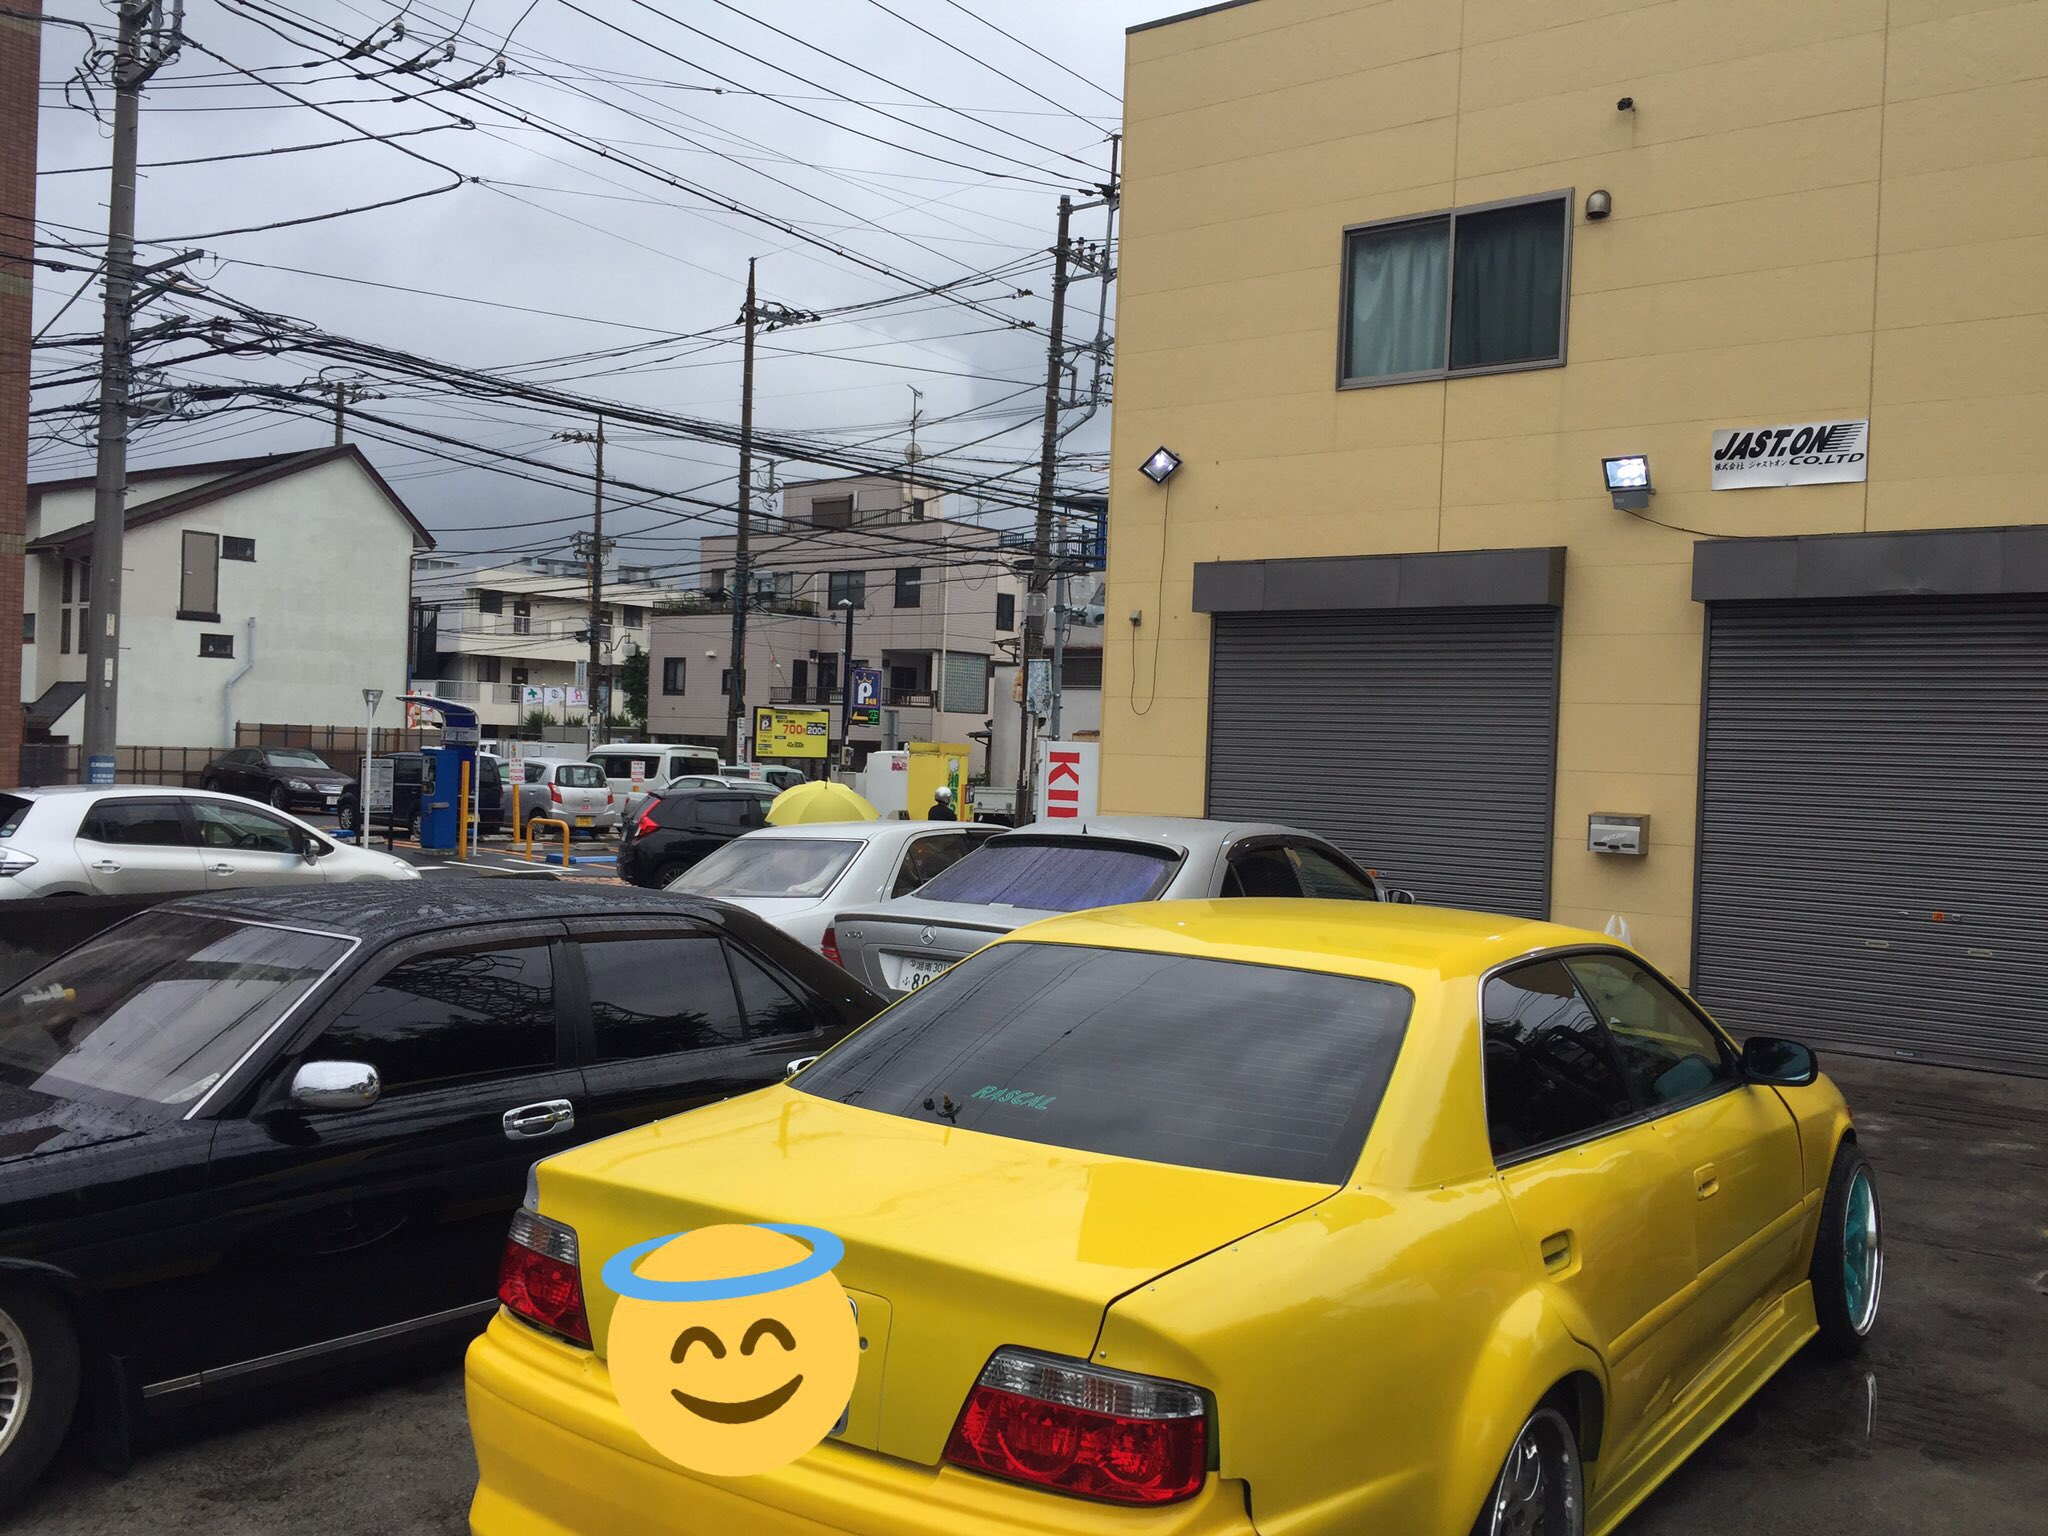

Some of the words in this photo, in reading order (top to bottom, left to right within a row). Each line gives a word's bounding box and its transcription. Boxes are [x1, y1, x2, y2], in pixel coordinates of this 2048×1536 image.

[1714, 462, 1744, 472] 株式会社
[1748, 460, 1786, 469] ジャストオン
[971, 1085, 1057, 1110] RASCAL
